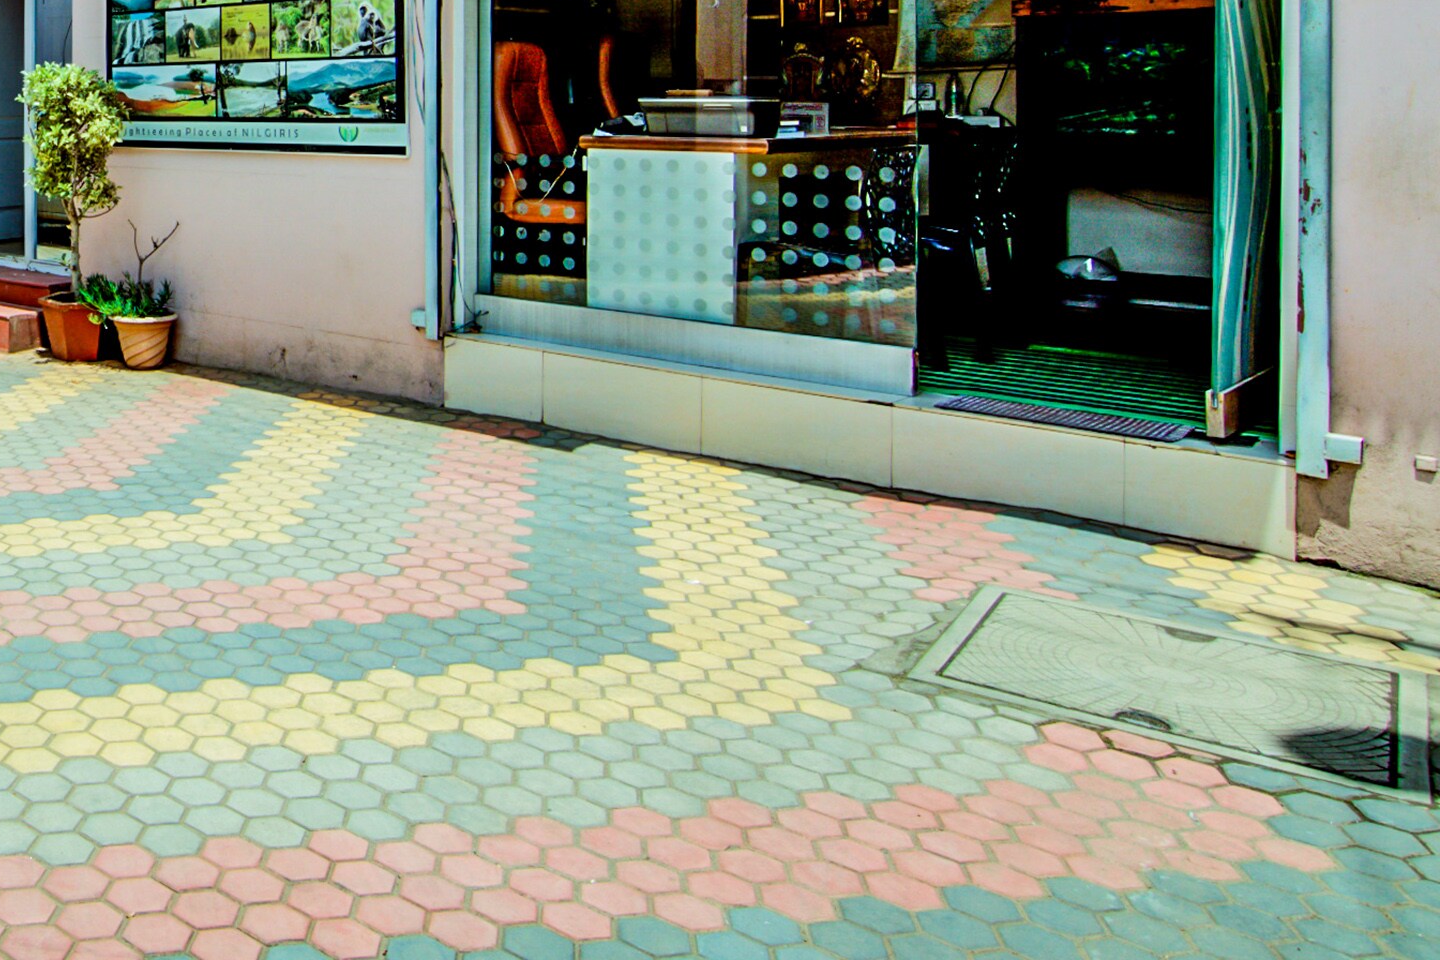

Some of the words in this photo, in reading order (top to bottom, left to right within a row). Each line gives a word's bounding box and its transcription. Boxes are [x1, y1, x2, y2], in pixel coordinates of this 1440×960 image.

[185, 127, 223, 137] Places
[226, 127, 238, 137] of
[241, 128, 300, 138] NILGIRIS
